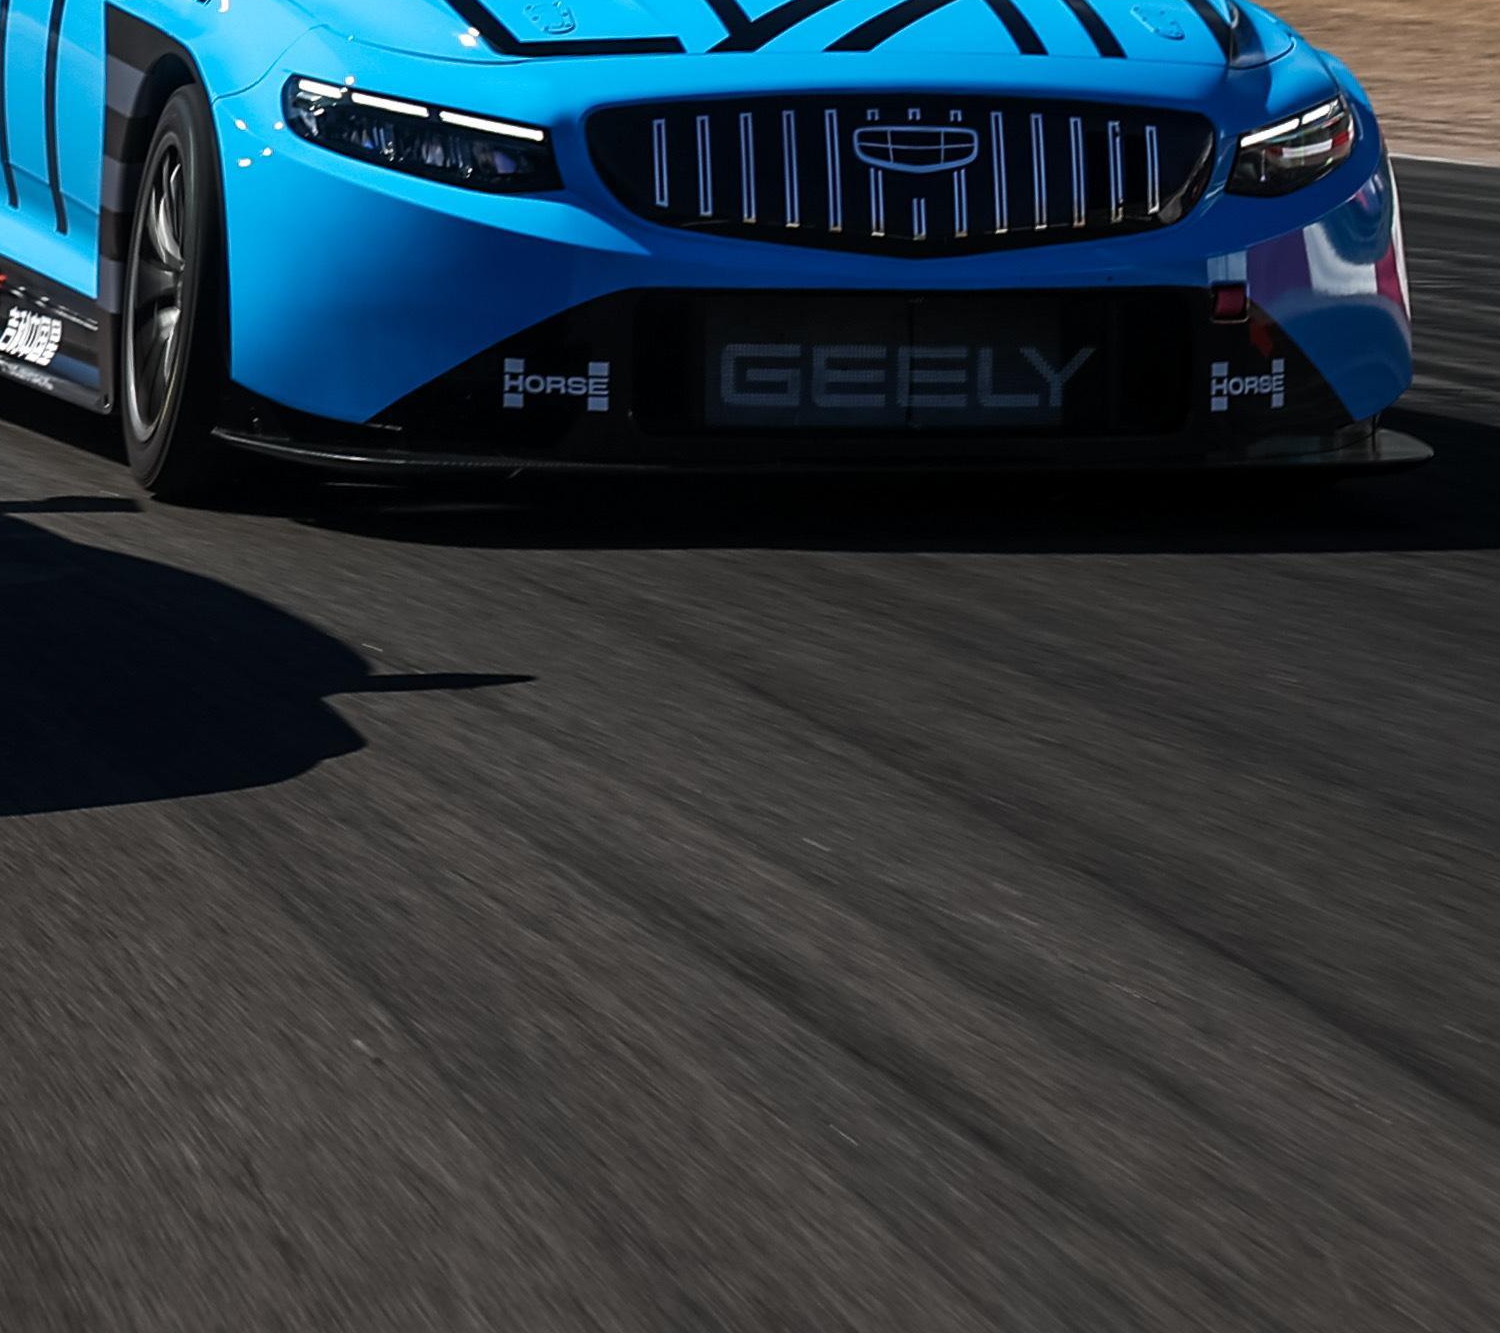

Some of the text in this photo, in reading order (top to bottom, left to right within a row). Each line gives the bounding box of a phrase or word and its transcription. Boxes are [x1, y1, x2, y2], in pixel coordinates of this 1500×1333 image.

[503, 374, 610, 396] HORSE
[721, 343, 1096, 407] GEELY
[1211, 374, 1286, 396] HORSE
